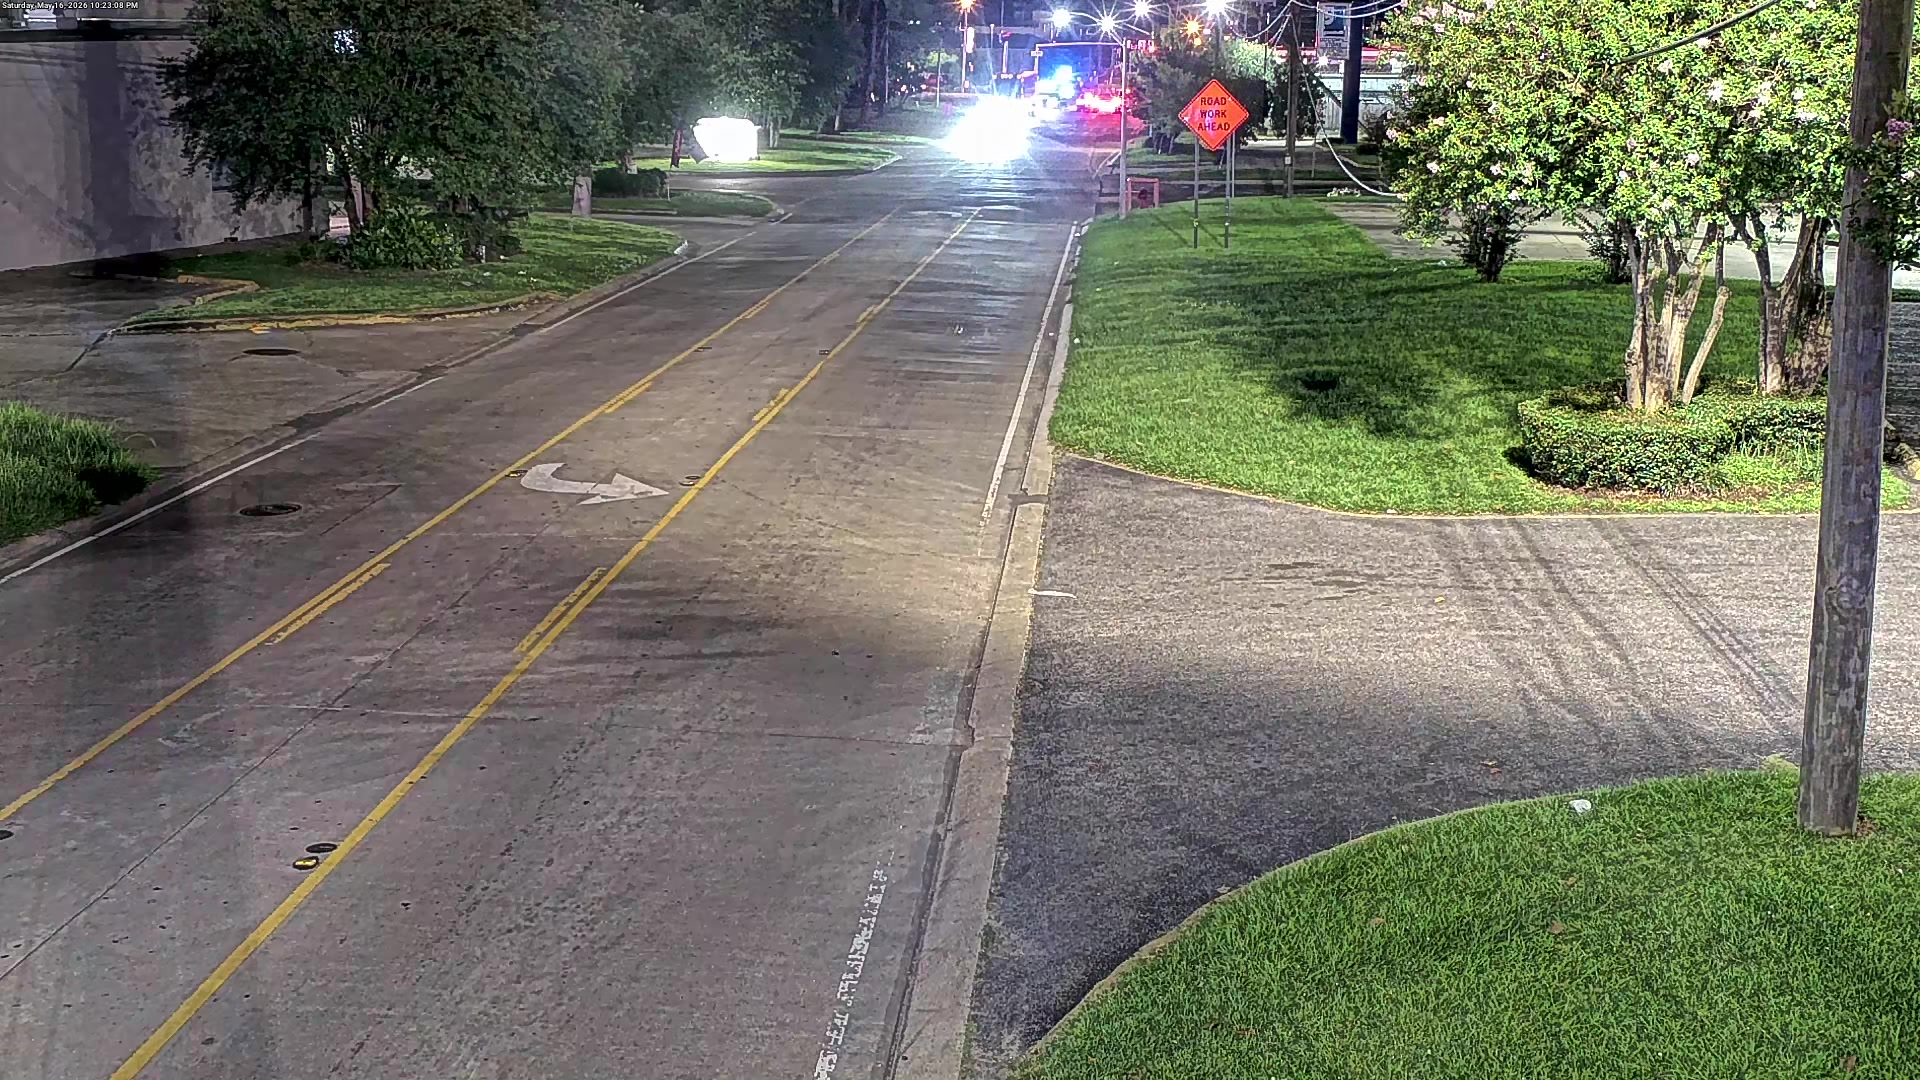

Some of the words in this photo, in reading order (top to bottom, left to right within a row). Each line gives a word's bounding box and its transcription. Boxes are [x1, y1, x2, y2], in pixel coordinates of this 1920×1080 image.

[1200, 97, 1227, 106] ROAD
[1200, 109, 1227, 118] WORK
[1197, 122, 1231, 131] AHEAD
